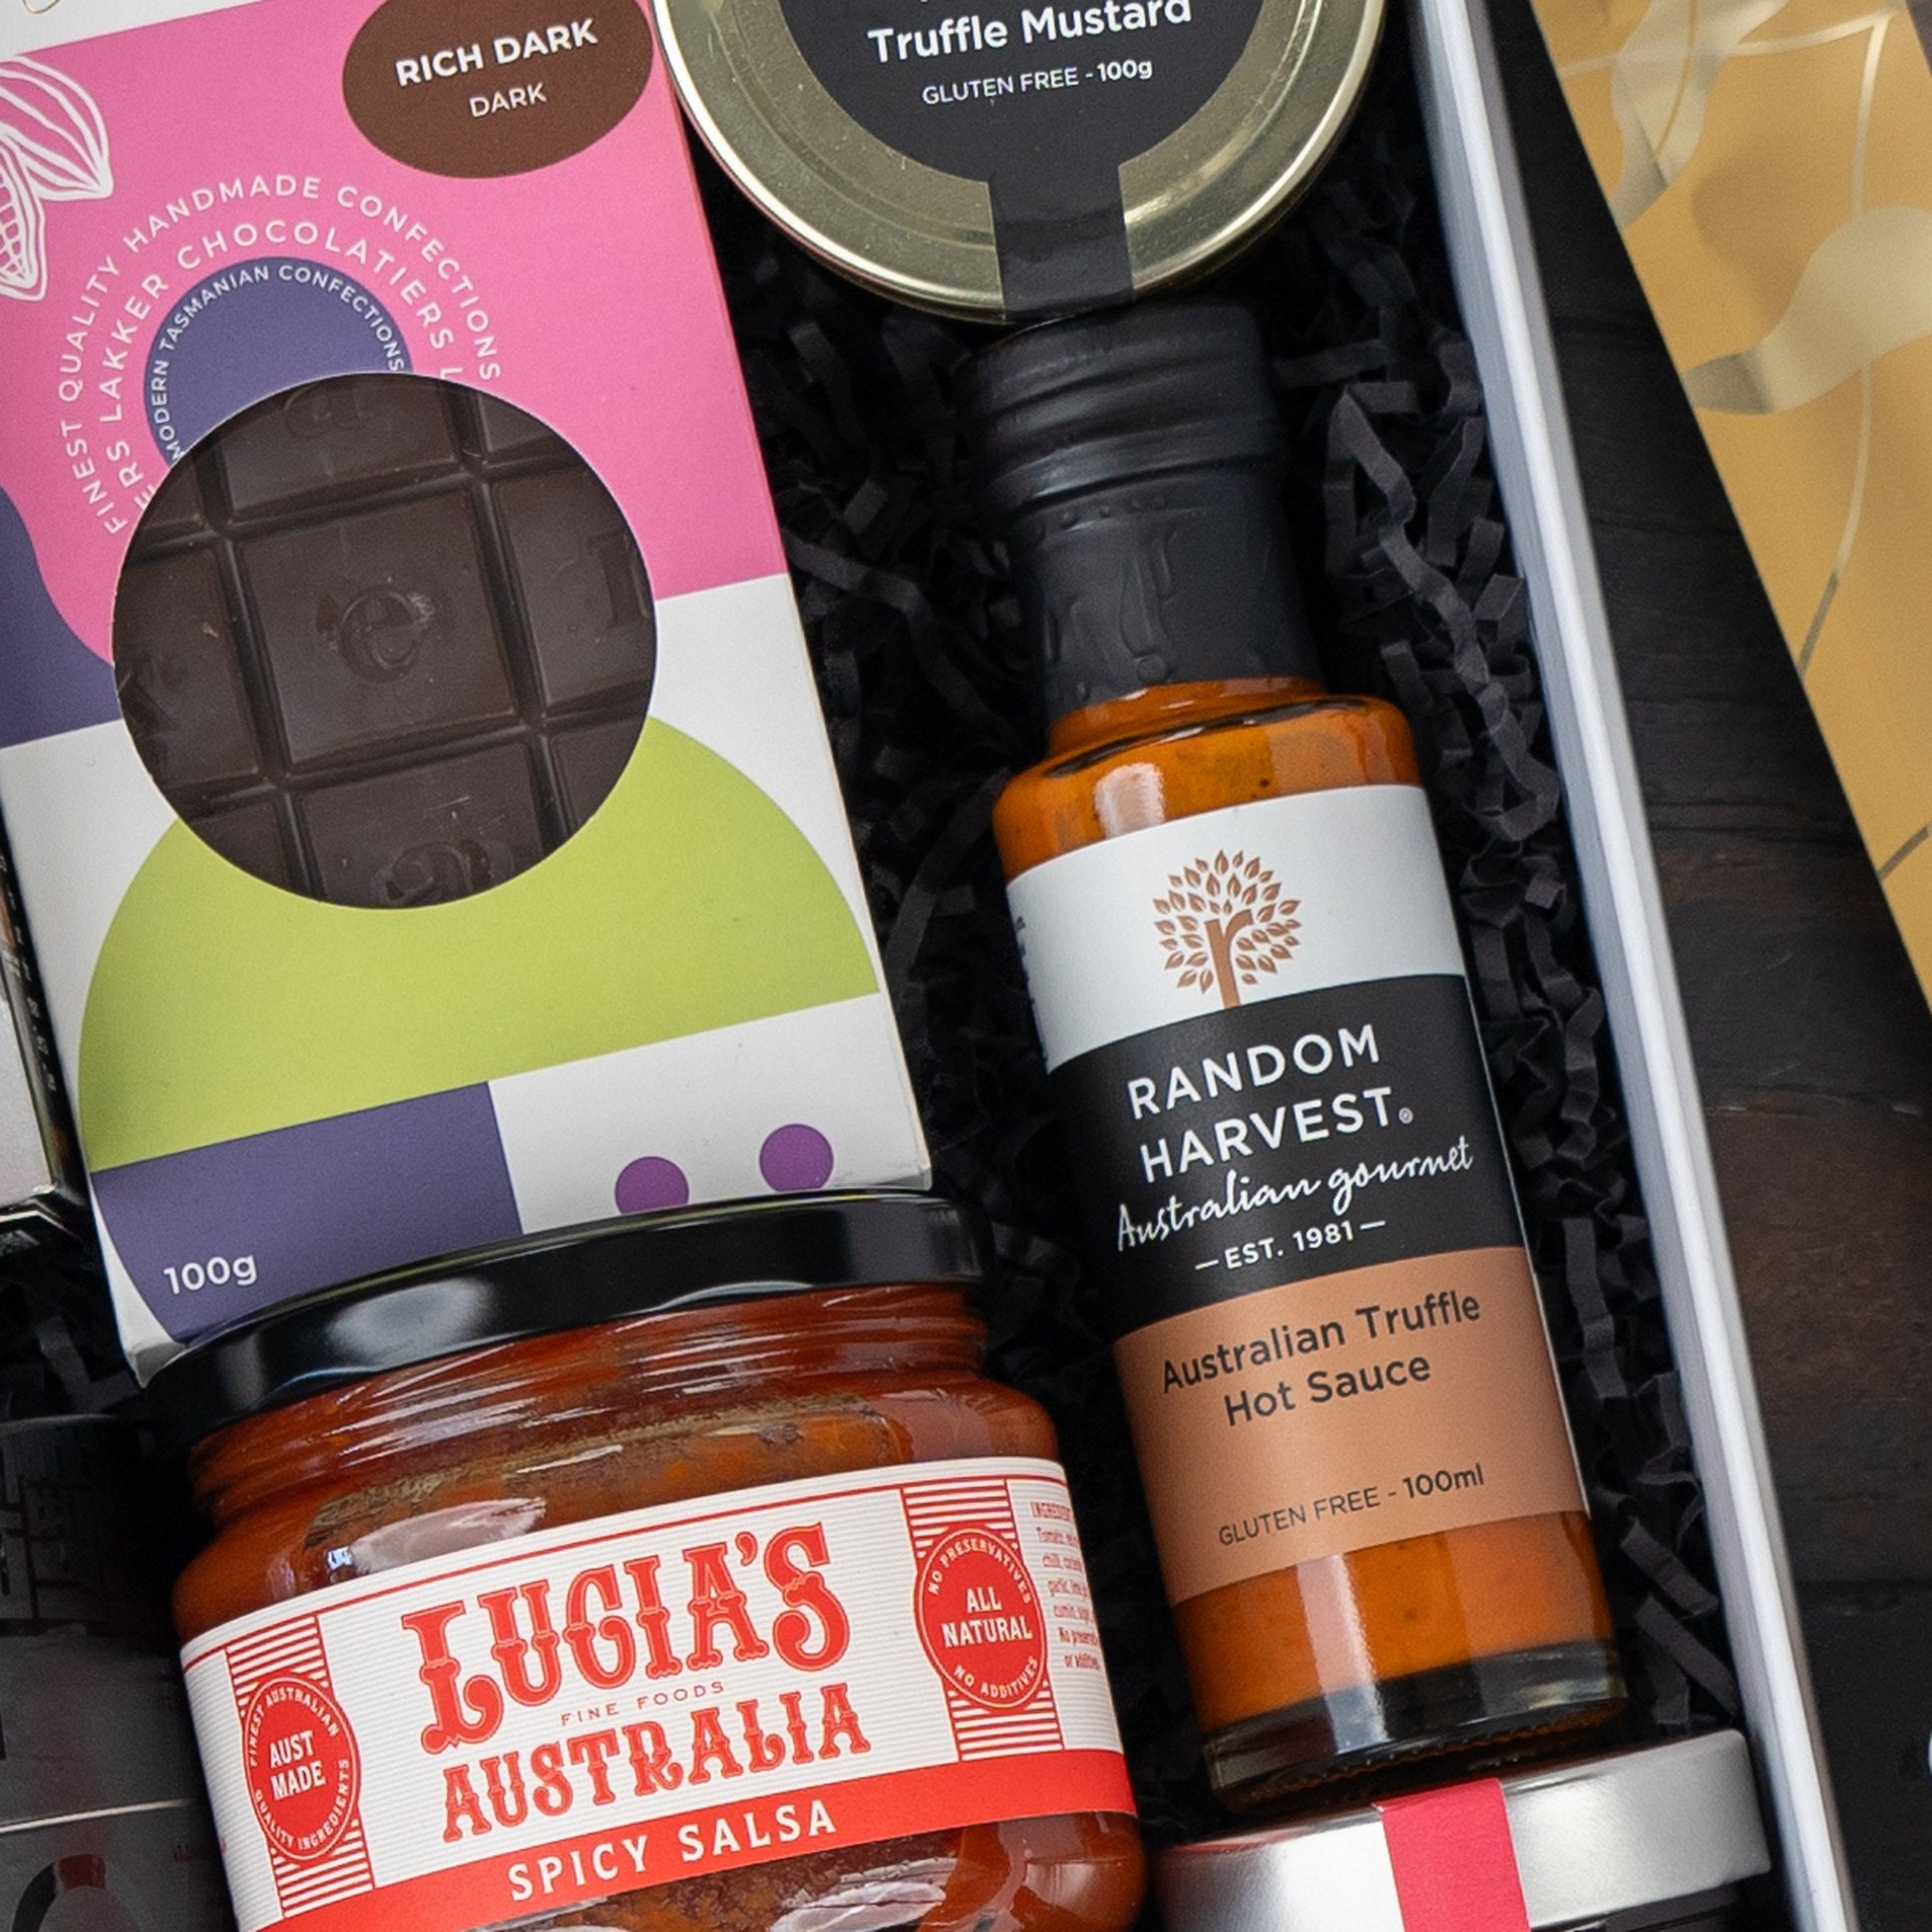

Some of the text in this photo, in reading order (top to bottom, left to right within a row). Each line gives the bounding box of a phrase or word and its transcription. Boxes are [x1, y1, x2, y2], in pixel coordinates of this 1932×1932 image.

[395, 18, 598, 87] RICH DARK
[868, 0, 1192, 63] Truffle Mustard
[469, 82, 547, 118] DARK
[922, 76, 1013, 105] GLUTEN
[1020, 67, 1079, 92] FREE
[1097, 60, 1152, 83] 100g
[59, 175, 501, 535] FINEST QUALITY HANDMADE CONFECTIONS
[100, 273, 169, 422] LAKKER
[177, 220, 454, 349] CHOCOLATIERS
[152, 265, 404, 461] MODERN TASMANIAN CONFECTIONS
[1127, 1024, 1379, 1119] RANDOM
[1117, 1135, 1473, 1252] Australian gourmet
[163, 1255, 257, 1296] 100g
[1163, 1291, 1480, 1393] Australian Truffle
[1224, 1356, 1431, 1426] Hot Sauce
[1219, 1505, 1307, 1546] GLUTEN
[1314, 1487, 1380, 1521] FREE
[1403, 1463, 1484, 1499] 100ml
[928, 1570, 943, 1595] NO
[940, 1537, 1031, 1604] PRESERVATIVES
[966, 1586, 1002, 1614] ALL
[401, 1521, 850, 1754] LUCIA'S
[942, 1616, 1033, 1648] NATURAL
[561, 1681, 724, 1727] FINE FOODS
[954, 1664, 975, 1687] NO
[980, 1656, 1037, 1699] ADDITIVES
[249, 1687, 339, 1766] FINEST AUSTRALIAN
[269, 1731, 314, 1768] AUST
[270, 1759, 326, 1800] MADE
[443, 1683, 871, 1843] AUSTRALIA
[255, 1758, 349, 1850] QUALITY INGREDIENTS
[508, 1799, 837, 1901] SPICY SALSA
